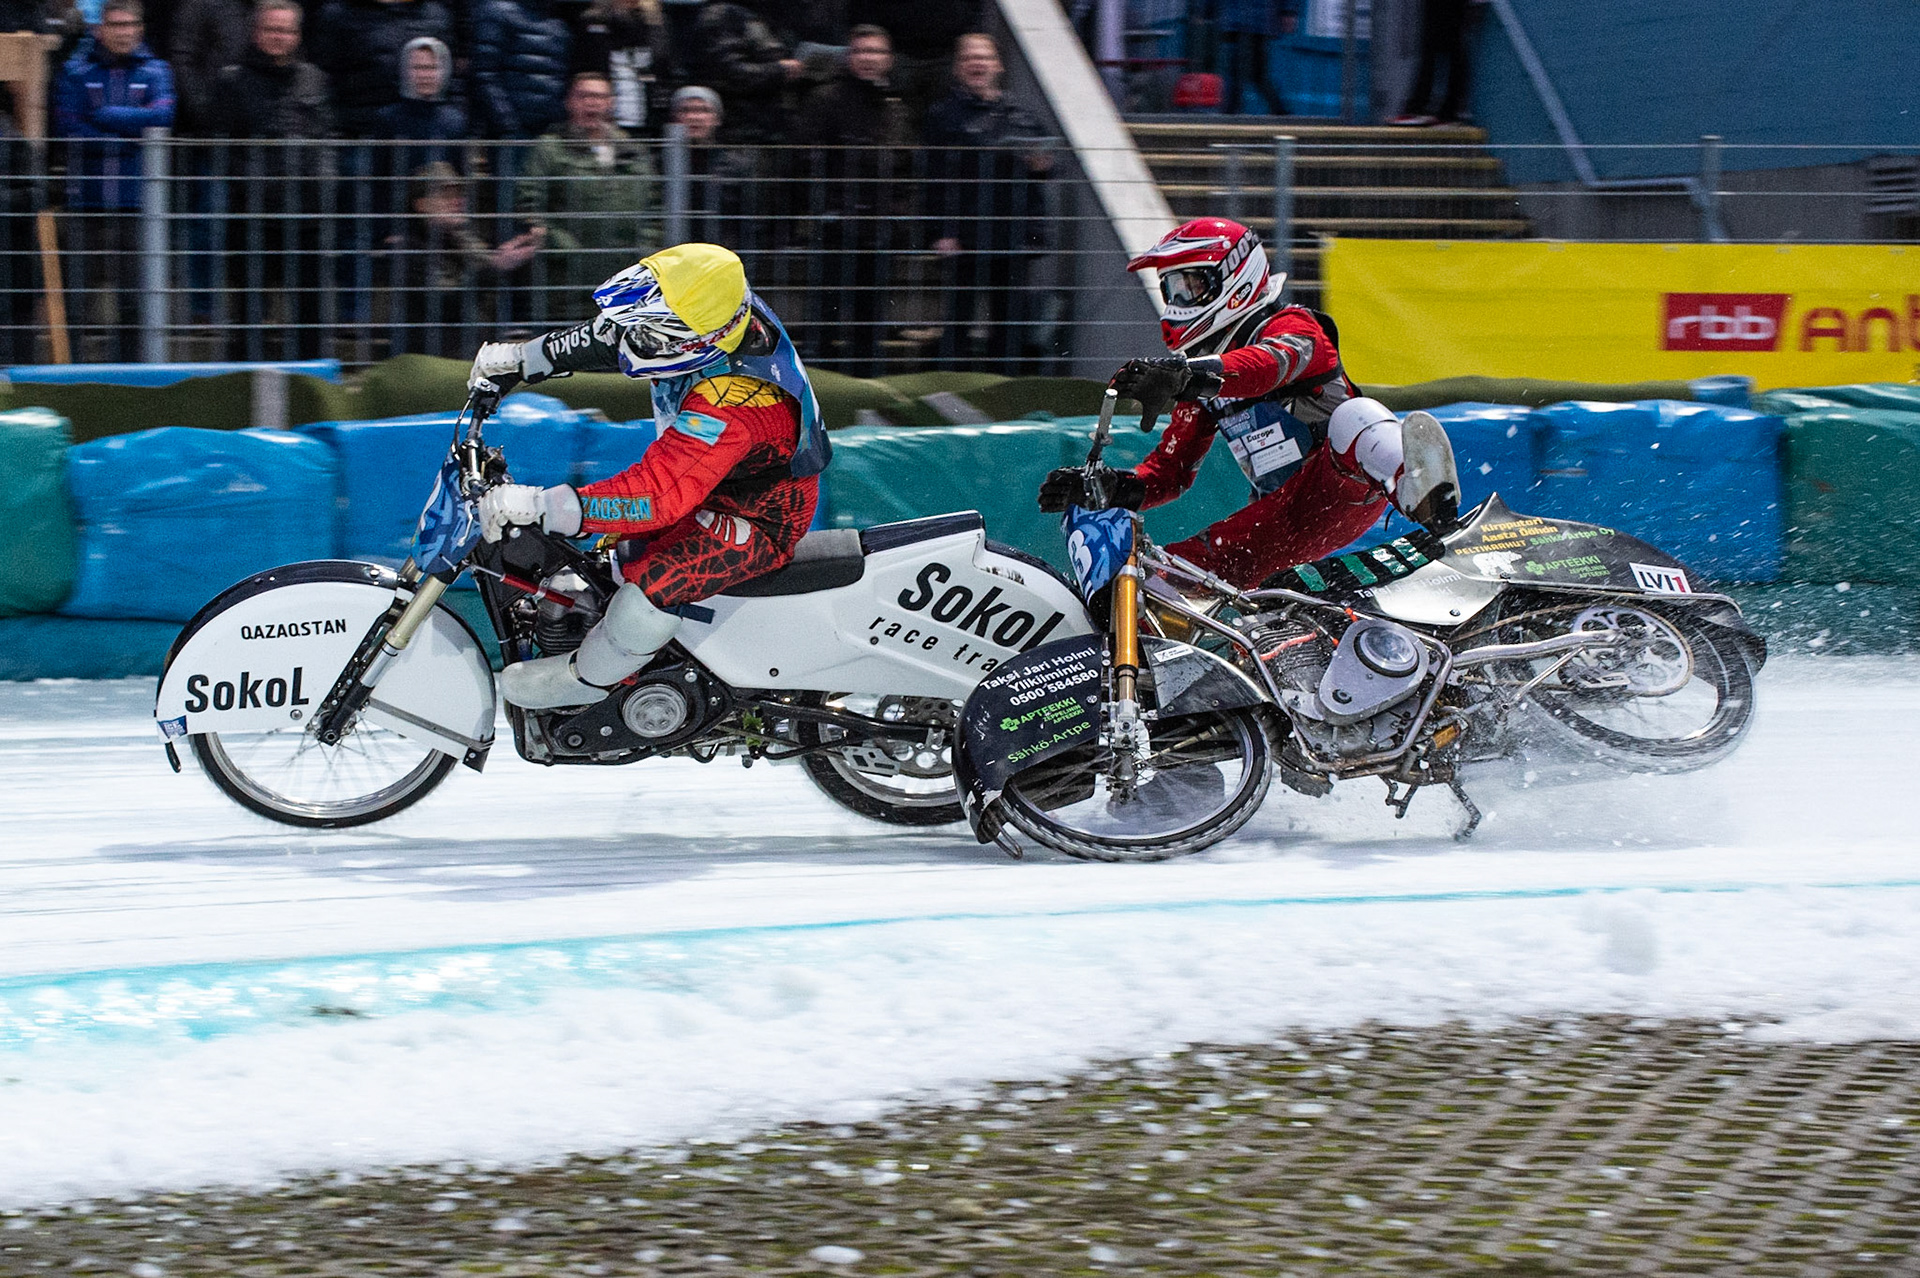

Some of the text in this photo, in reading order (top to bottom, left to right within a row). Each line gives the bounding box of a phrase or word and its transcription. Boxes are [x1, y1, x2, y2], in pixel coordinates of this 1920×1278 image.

[1667, 305, 1777, 340] rbb
[1480, 517, 1544, 532] Kirpputori
[1598, 527, 1615, 536] Oy
[1454, 540, 1526, 555] PELTIKARHUT
[1482, 532, 1518, 543] Aasta
[1545, 555, 1601, 571] APTEEKKI
[1638, 571, 1686, 593] LVI1
[241, 619, 346, 640] QAZAQSTAN
[869, 617, 939, 650] race
[980, 647, 1096, 690] Taksi Jari Holmi
[1008, 661, 1085, 692] Ylikiiminki
[1010, 669, 1098, 706] 0500 584580
[1020, 697, 1077, 723] APTEEKKI
[1008, 721, 1091, 763] Sähkö-Artpe
